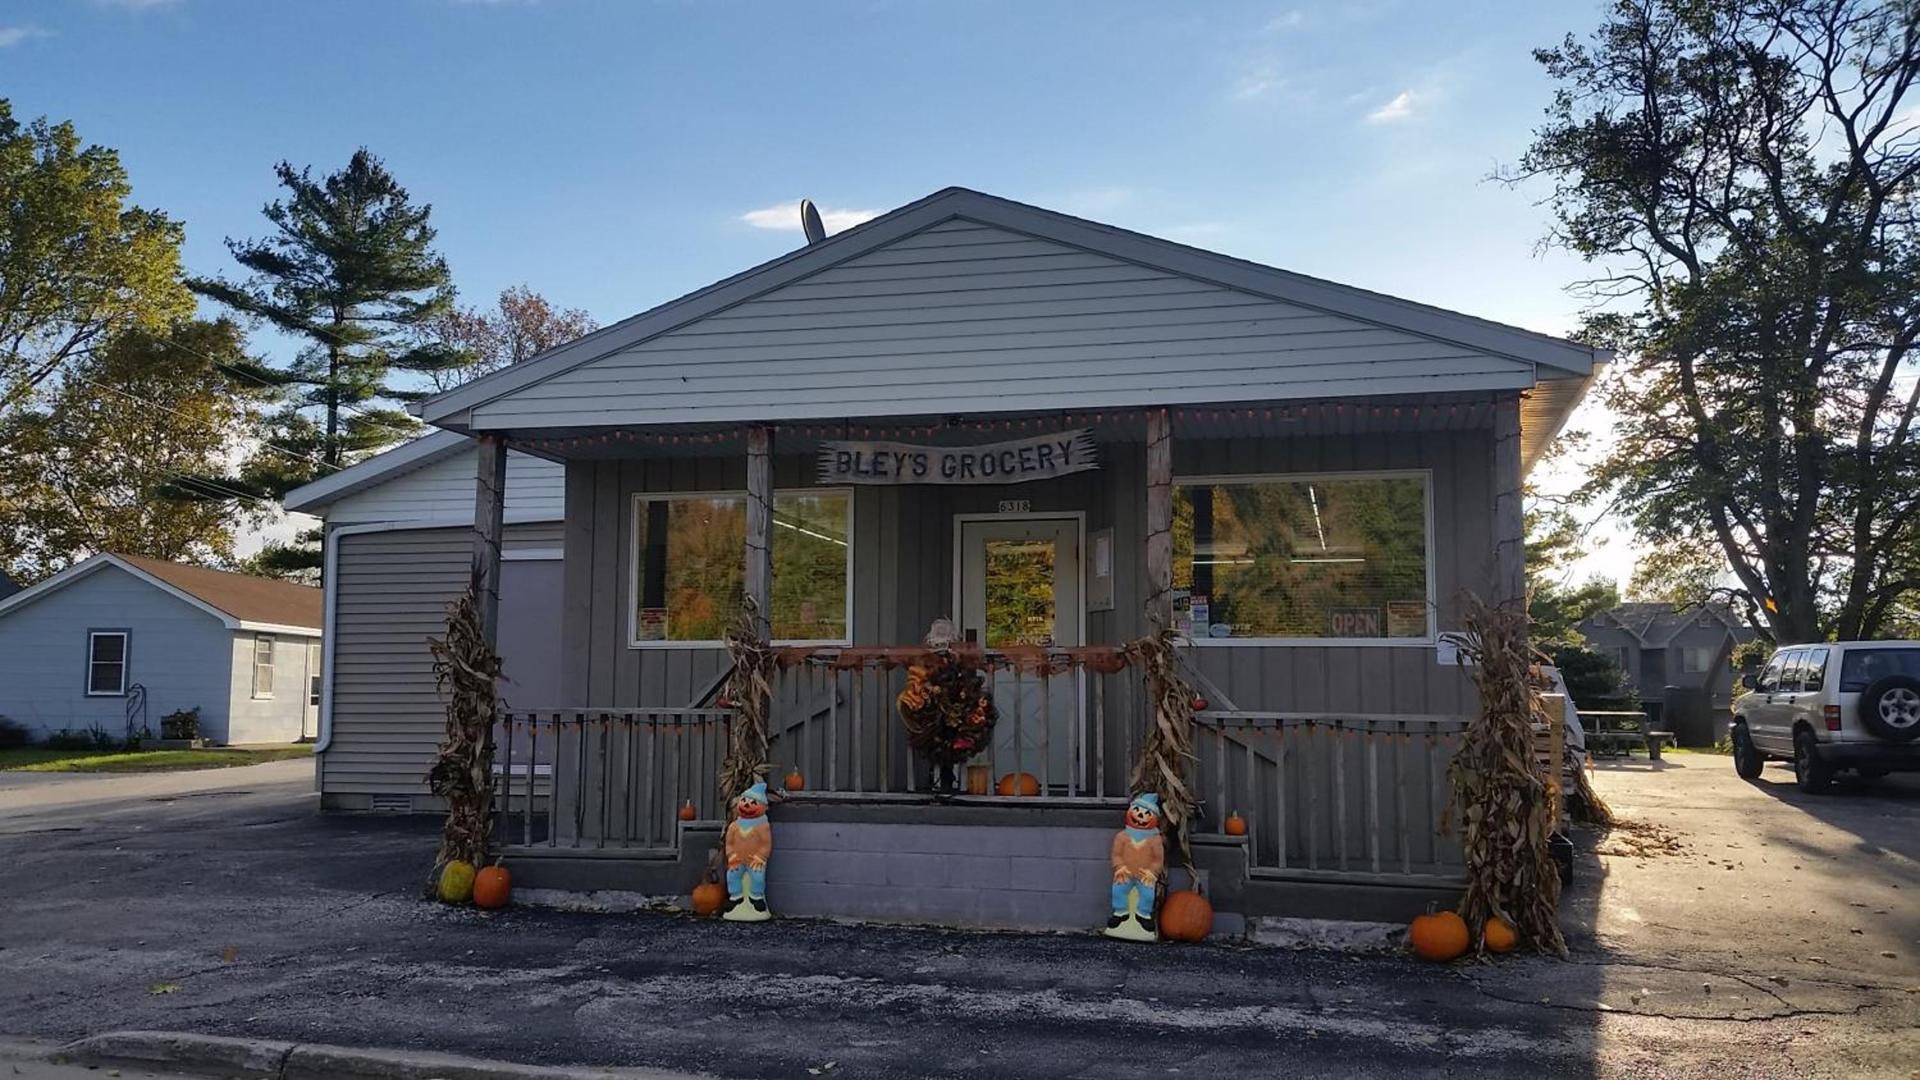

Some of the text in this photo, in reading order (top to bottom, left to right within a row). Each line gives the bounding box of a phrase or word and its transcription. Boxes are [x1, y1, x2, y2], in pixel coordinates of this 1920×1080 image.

[836, 440, 1072, 479] BLEY'S GROCERY
[1000, 501, 1029, 512] 6318
[1331, 613, 1378, 634] OPEN
